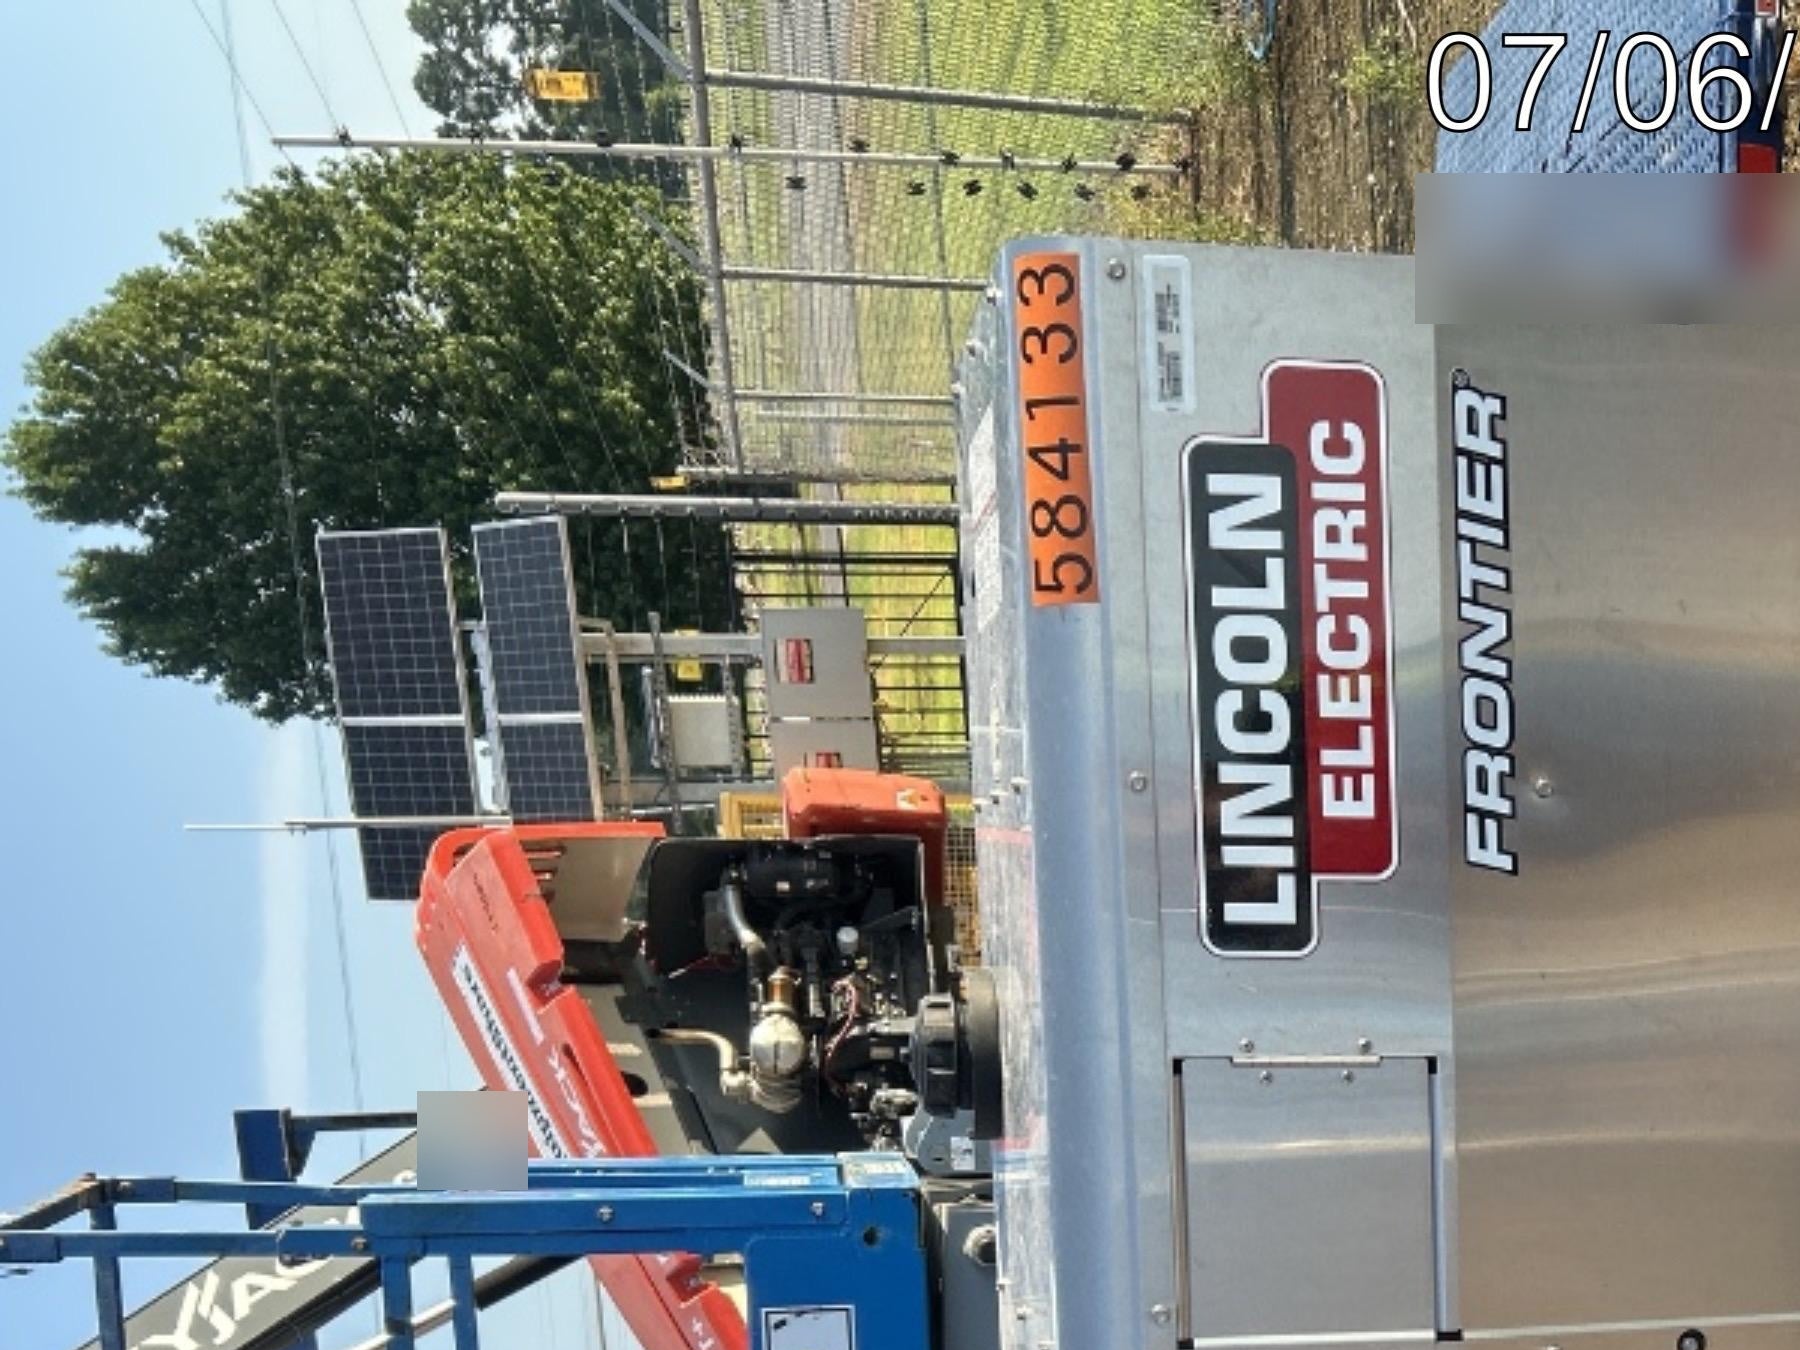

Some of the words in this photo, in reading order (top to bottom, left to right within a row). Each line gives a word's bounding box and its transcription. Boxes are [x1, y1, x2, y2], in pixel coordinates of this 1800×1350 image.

[1015, 263, 1093, 595] 584133
[1310, 418, 1376, 821] ELECTRIC
[1206, 471, 1298, 926] LINCOLN
